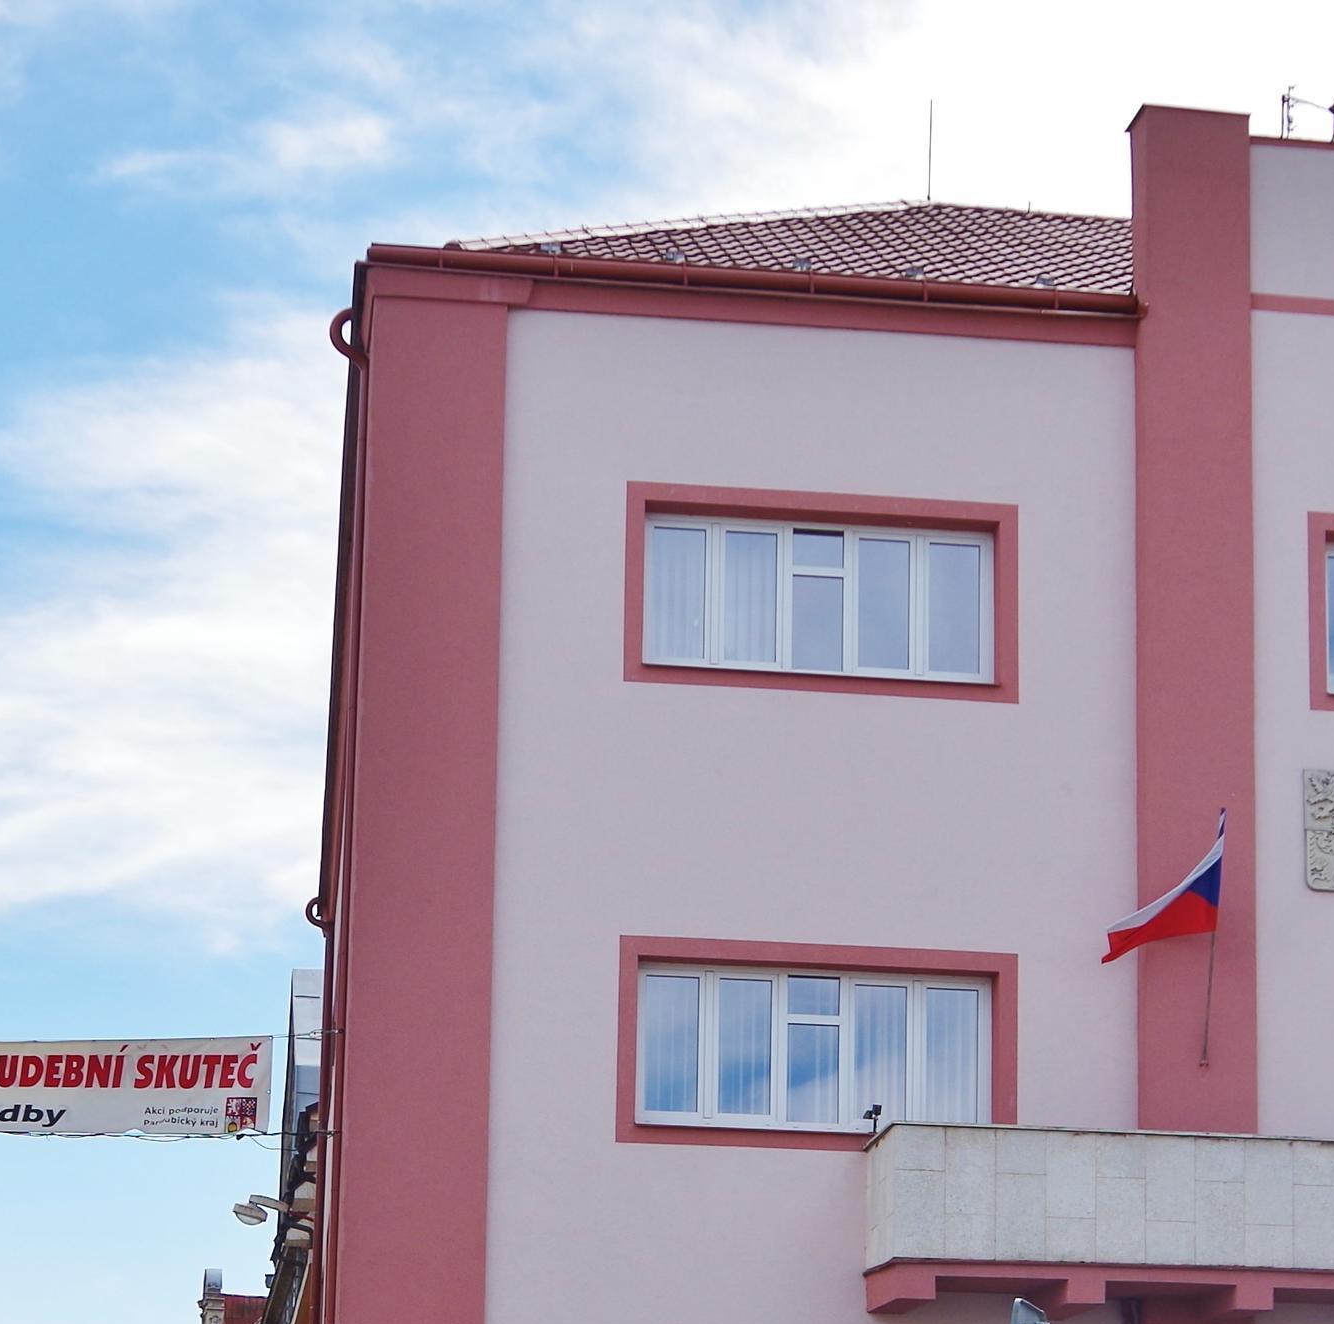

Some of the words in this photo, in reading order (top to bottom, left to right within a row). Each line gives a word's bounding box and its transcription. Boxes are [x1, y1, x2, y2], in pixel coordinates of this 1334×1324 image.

[133, 1042, 263, 1089] SKUTEČ
[144, 1106, 166, 1115] Akci
[200, 1118, 219, 1128] kraj
